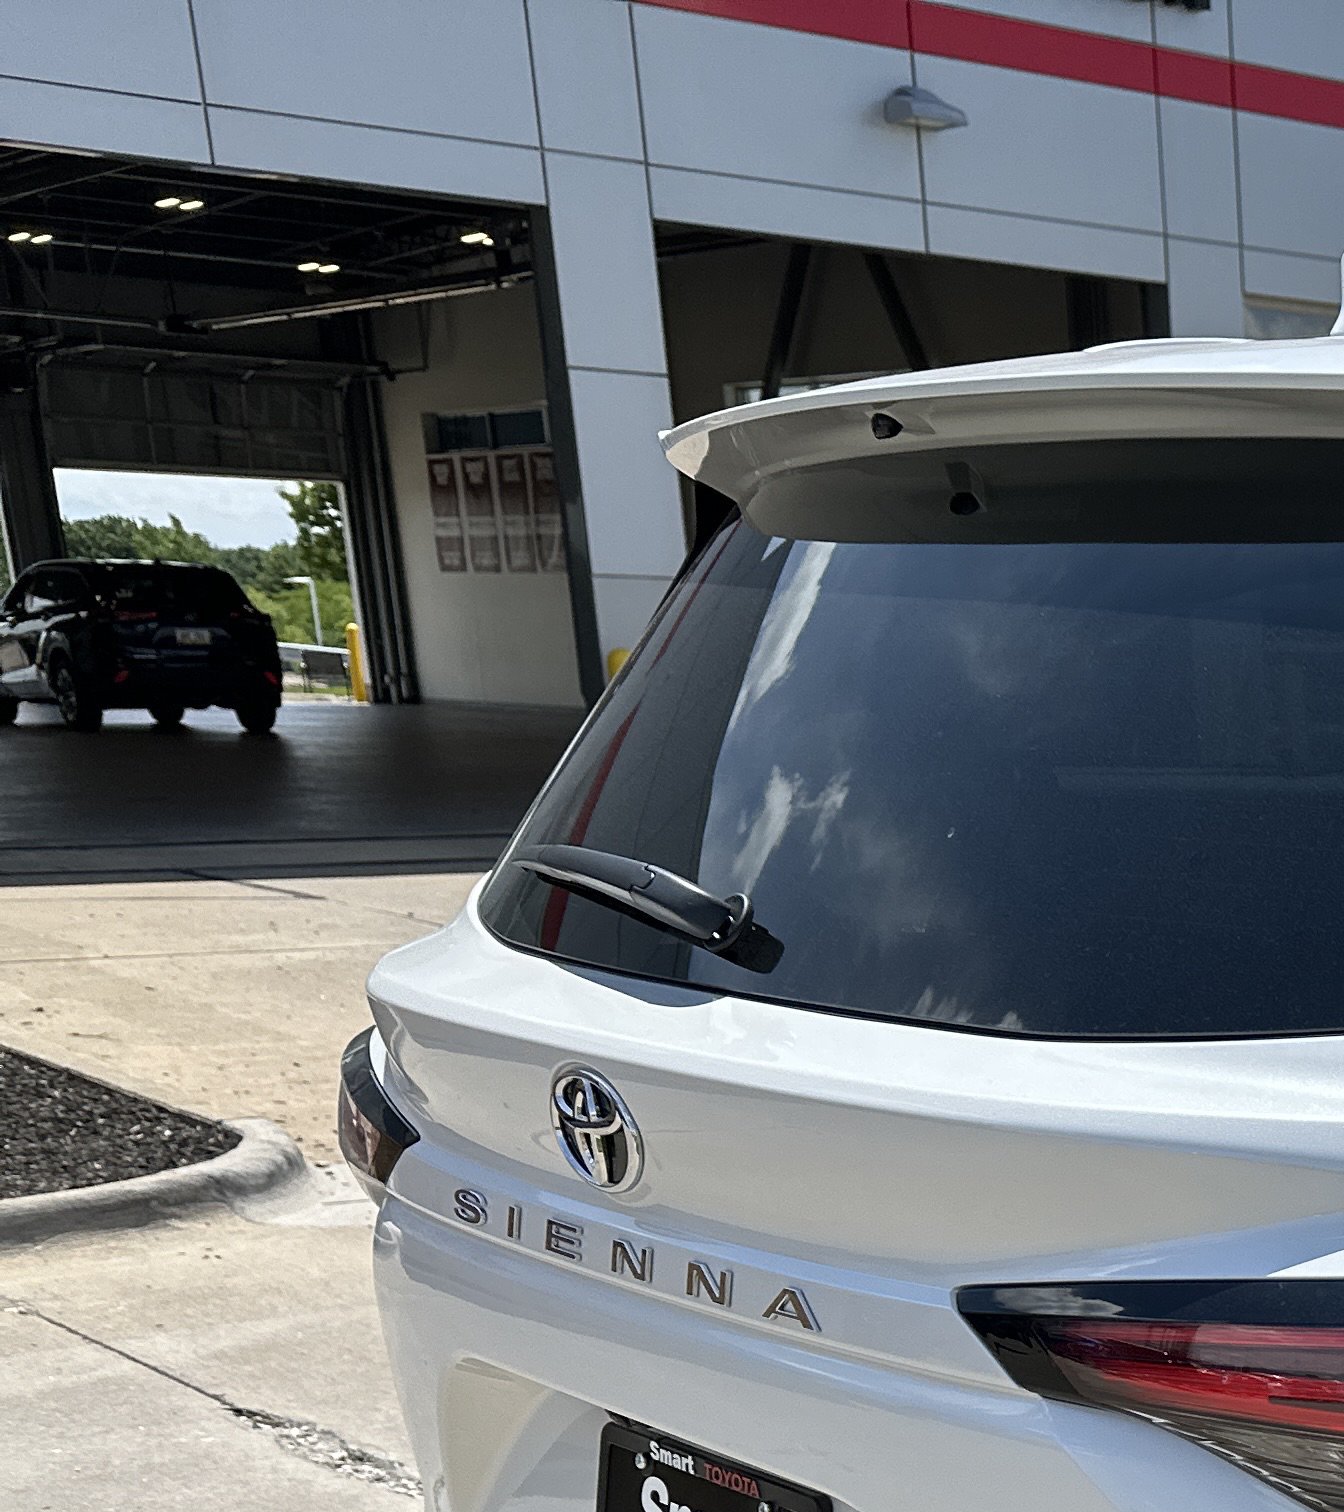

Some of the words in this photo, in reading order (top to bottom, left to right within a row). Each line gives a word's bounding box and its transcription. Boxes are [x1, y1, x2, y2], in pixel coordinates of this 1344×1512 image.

[453, 1187, 822, 1333] SIENNA
[649, 1440, 696, 1475] Smart
[703, 1462, 760, 1499] TOYOTA
